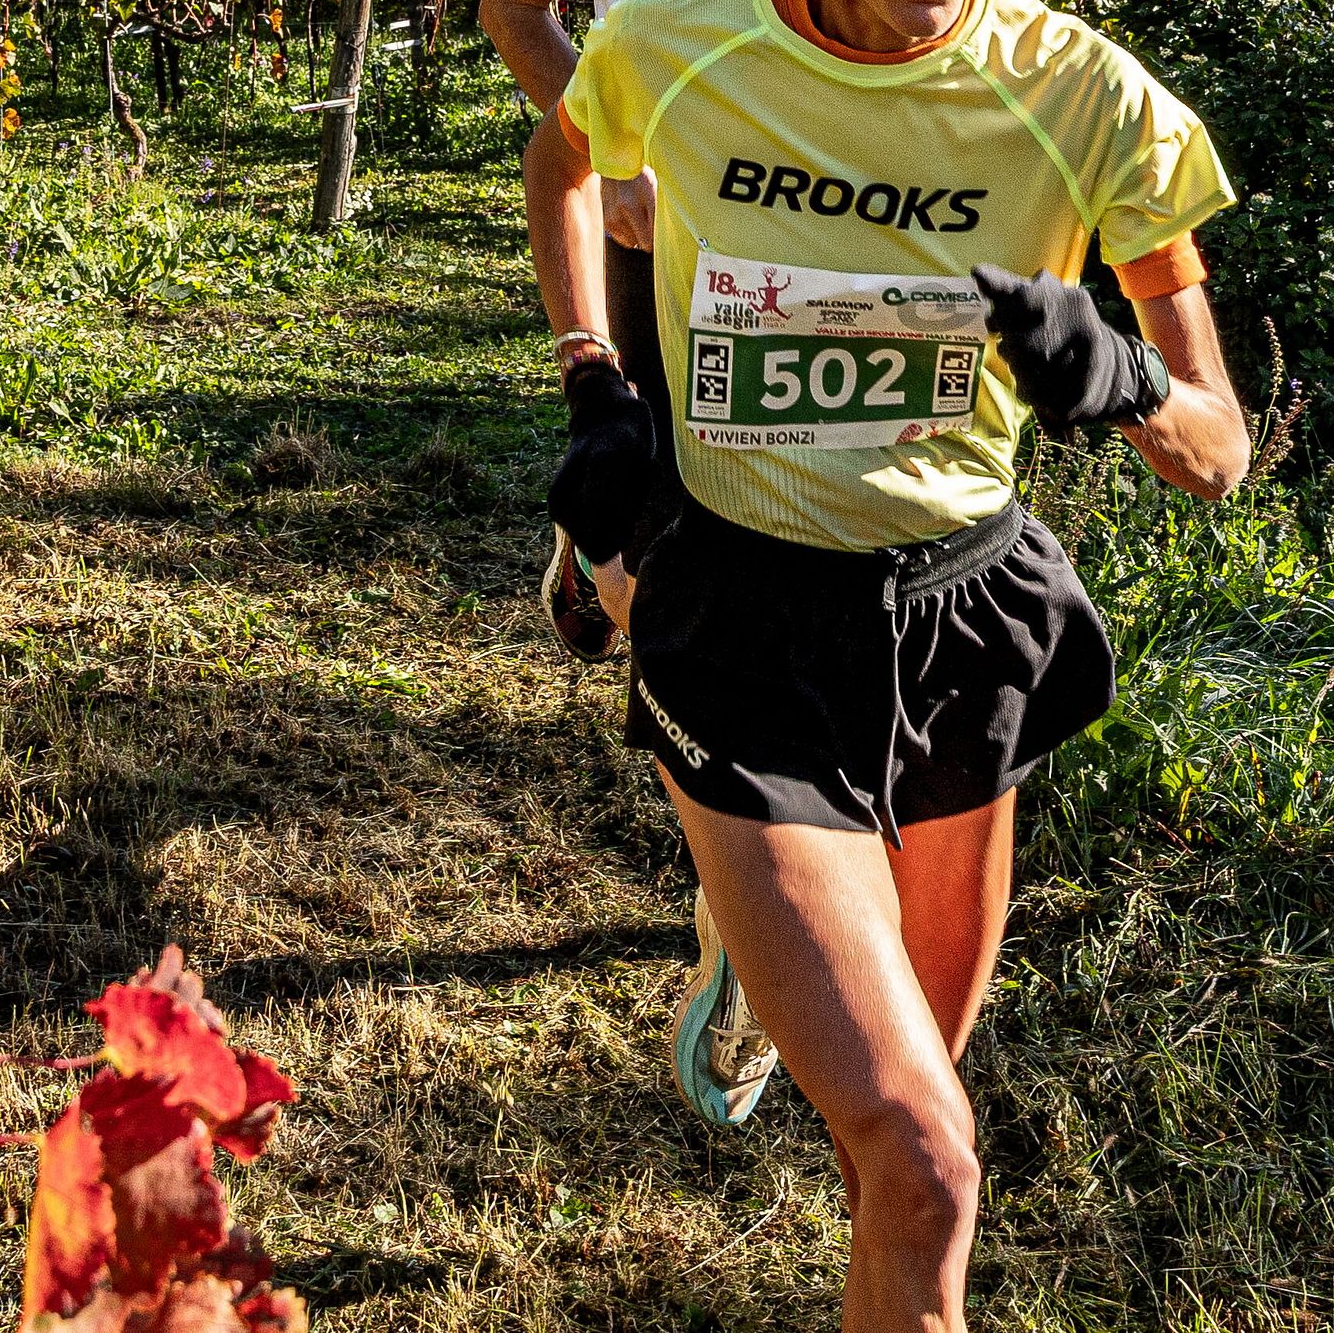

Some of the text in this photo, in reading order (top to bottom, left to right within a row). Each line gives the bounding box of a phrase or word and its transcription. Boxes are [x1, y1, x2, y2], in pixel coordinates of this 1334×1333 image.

[718, 157, 989, 233] BROOKS
[805, 299, 874, 311] SALOMON
[911, 291, 982, 303] COMISA
[714, 302, 755, 318] valle
[714, 314, 760, 331] segni
[760, 348, 906, 411] 502
[709, 429, 816, 445] VIVIEN BONZI
[638, 678, 710, 769] BROOKS
